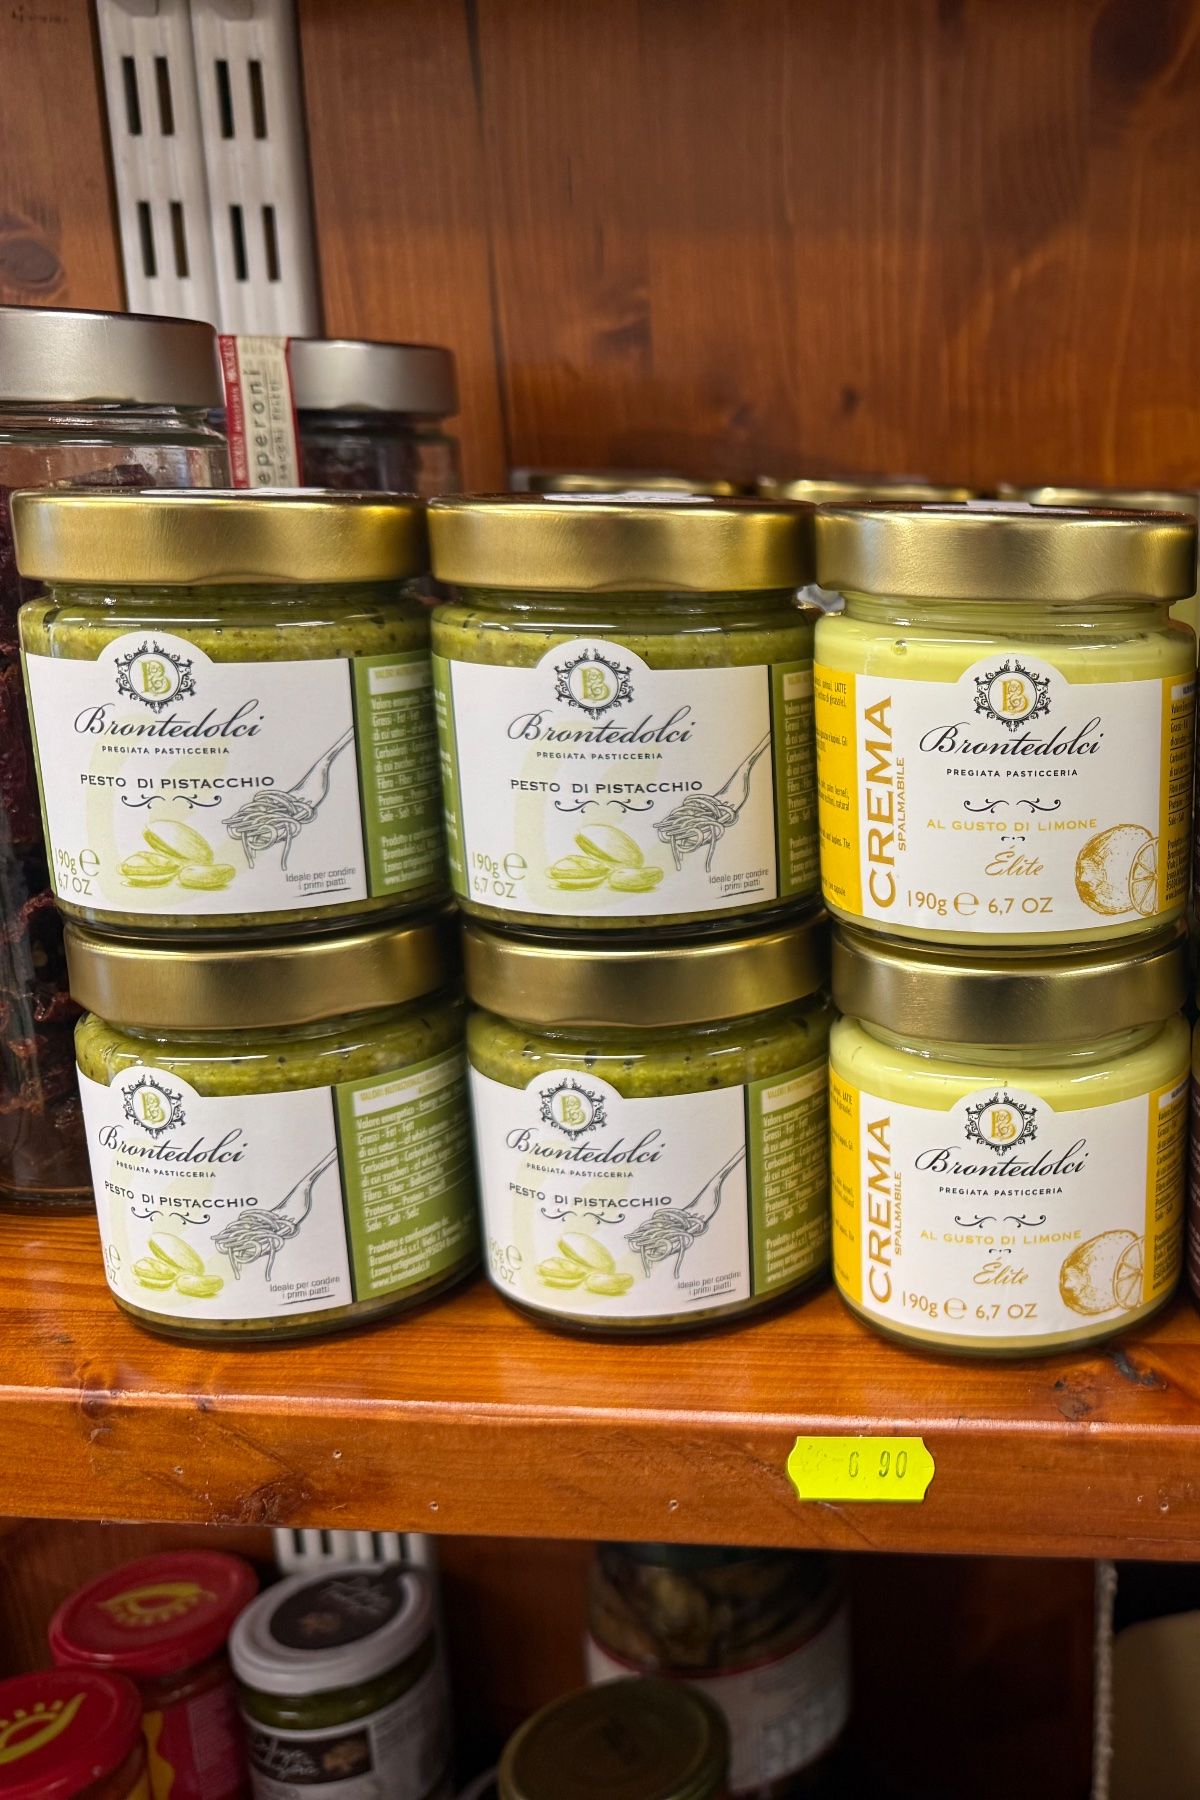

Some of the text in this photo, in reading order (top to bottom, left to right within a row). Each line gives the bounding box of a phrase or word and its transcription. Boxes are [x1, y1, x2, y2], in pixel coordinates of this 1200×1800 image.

[243, 369, 272, 484] eperoni
[74, 699, 264, 738] Brontedolci
[508, 705, 696, 744] Brontedolci
[919, 717, 1104, 756] Brontedolci
[102, 745, 230, 755] PREGIATA PASTICCERIA
[536, 752, 663, 760] PREGIATA PASTICCERIA
[81, 774, 274, 789] PESTO DI PISTACCHIO
[947, 769, 1078, 777] PREGIATA PASTICCERIA
[511, 780, 703, 794] PESTO DI PISTACCHIO
[864, 696, 896, 908] CREMA
[898, 757, 906, 851] SPALMABILE
[927, 819, 1097, 831] AL GUSTO DI LIMONE
[72, 879, 93, 895] OZ
[494, 880, 518, 898] OZ
[907, 890, 1053, 916] 190g 6,7 OZ
[98, 1125, 249, 1164] Brontedolci
[506, 1128, 666, 1165] Brontedolci
[914, 1138, 1089, 1177] Brontedolci
[116, 1161, 216, 1178] PREGIATA PASTICCERIA
[570, 1170, 633, 1178] PASTICCERIA
[105, 1181, 258, 1209] PESTO DI PISTACCHIO
[509, 1183, 672, 1207] PESTO DI PISTACCHIO
[939, 1186, 1063, 1196] PREGIATA PASTICCERIA
[868, 1116, 893, 1304] CREMA
[921, 1230, 1082, 1245] AL GUSTO DI LIMONE
[902, 1291, 1038, 1320] 190g 6,7 OZ
[879, 1451, 908, 1478] 90
